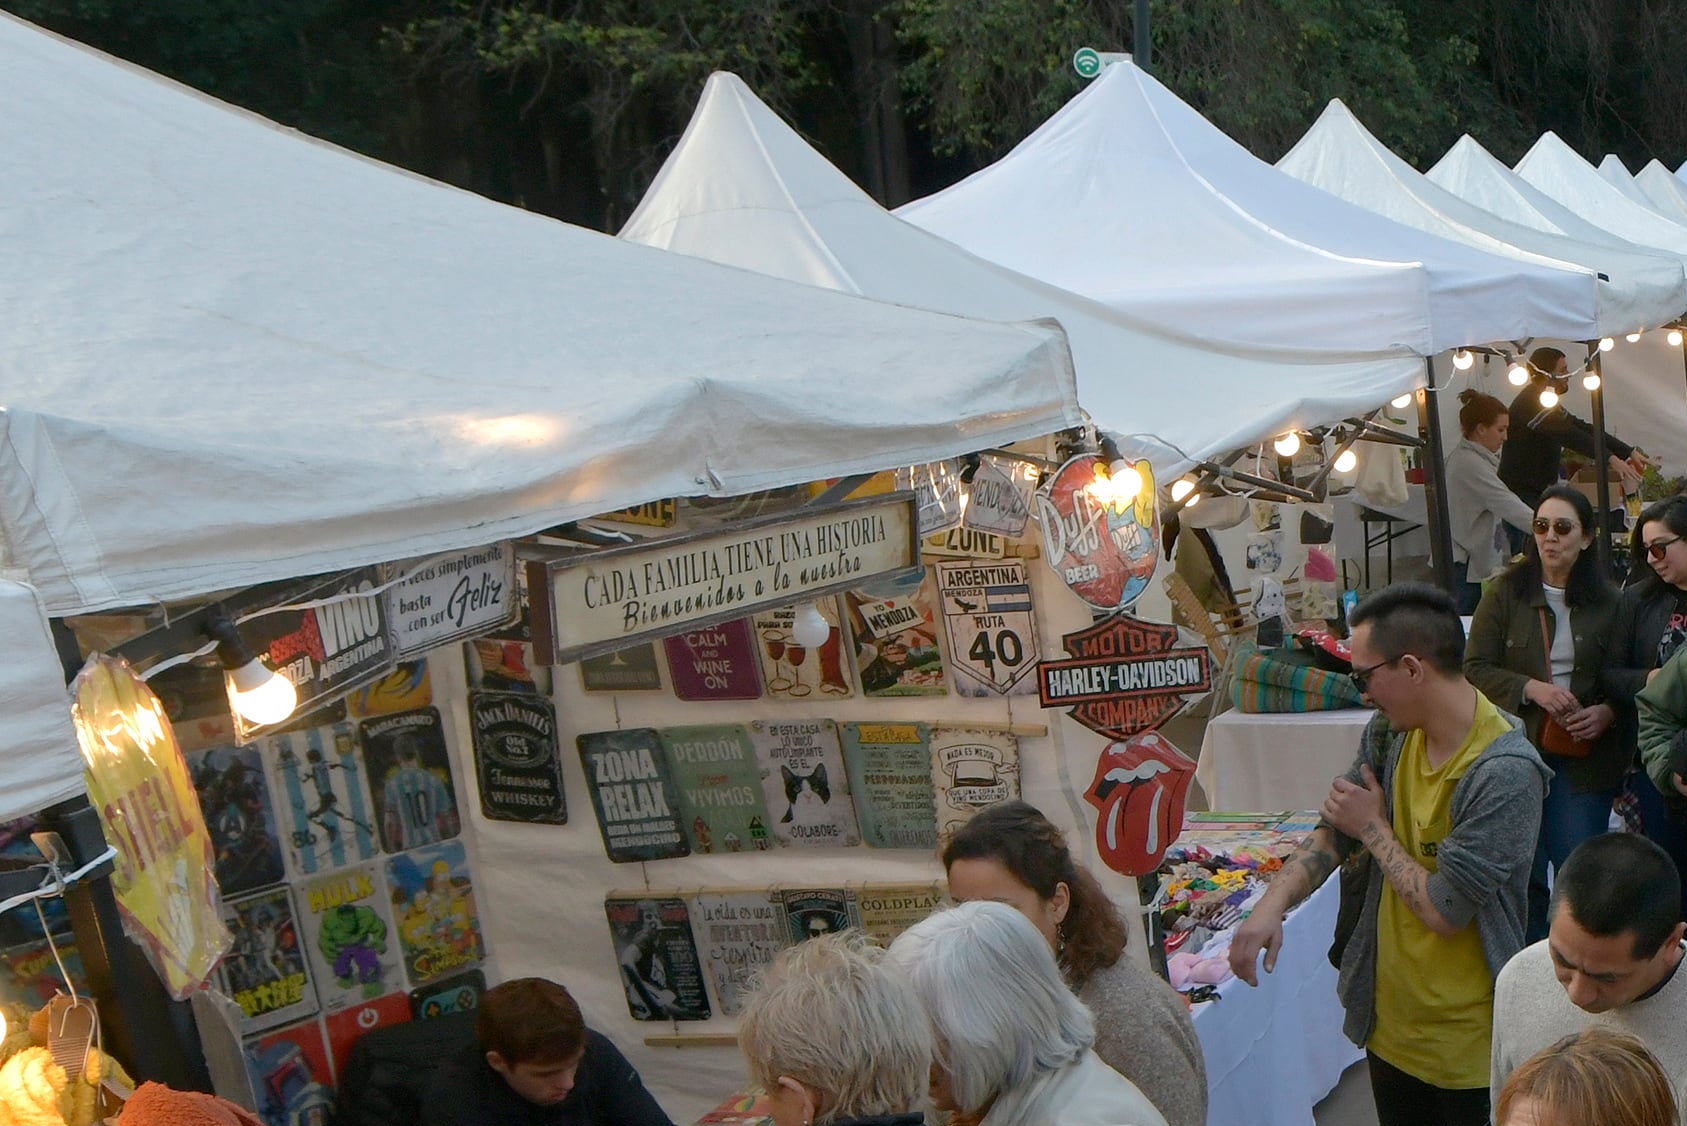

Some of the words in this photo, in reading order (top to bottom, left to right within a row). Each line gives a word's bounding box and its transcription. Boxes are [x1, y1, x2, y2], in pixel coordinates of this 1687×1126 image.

[1035, 483, 1103, 567] Duff
[584, 567, 638, 610] CADA
[645, 546, 722, 597] FAMILIA
[724, 535, 776, 574] TIENE
[781, 526, 813, 564] UNA
[816, 514, 887, 555] HISTORIA
[947, 567, 1020, 588] ARGENTINA
[1064, 564, 1099, 586] BEER
[399, 592, 432, 615] basta
[447, 571, 503, 629] Feliz
[623, 574, 746, 633] Bienvenidos
[754, 579, 765, 597] a
[774, 563, 791, 592] la
[800, 549, 863, 585] nuestra
[944, 589, 983, 598] MENDOZA
[868, 605, 920, 632] MENDOZA
[872, 603, 886, 613] YO
[408, 615, 428, 633] con
[430, 611, 446, 629] ser
[975, 615, 1006, 629] RUTA
[686, 634, 728, 648] CALM
[968, 629, 1023, 670] 40
[1081, 624, 1164, 657] MOTOR
[319, 635, 385, 683] ARGENTINA
[701, 650, 719, 659] AND
[693, 660, 734, 675] WINE
[1048, 657, 1201, 698] HARLEY-DAVIDSON
[704, 675, 729, 690] ON
[476, 706, 506, 731] JACK
[504, 702, 554, 736] DANIEL'S
[1087, 694, 1172, 734] COMPANY
[779, 724, 799, 736] ESTA
[799, 724, 821, 736] CASA
[789, 758, 799, 769] ES
[801, 758, 811, 769] EL
[946, 749, 963, 761] NADA
[965, 747, 973, 756] ES
[591, 748, 659, 784] ZONA
[490, 768, 552, 790] Tennessee
[491, 790, 556, 807] WHISKEY
[599, 780, 671, 823] RELAX
[685, 785, 755, 808] VIVIMOS
[978, 787, 995, 795] COPA
[403, 790, 431, 829] 10
[306, 874, 376, 915] HULK
[860, 896, 943, 912] COLDPLAY
[739, 906, 752, 919] es
